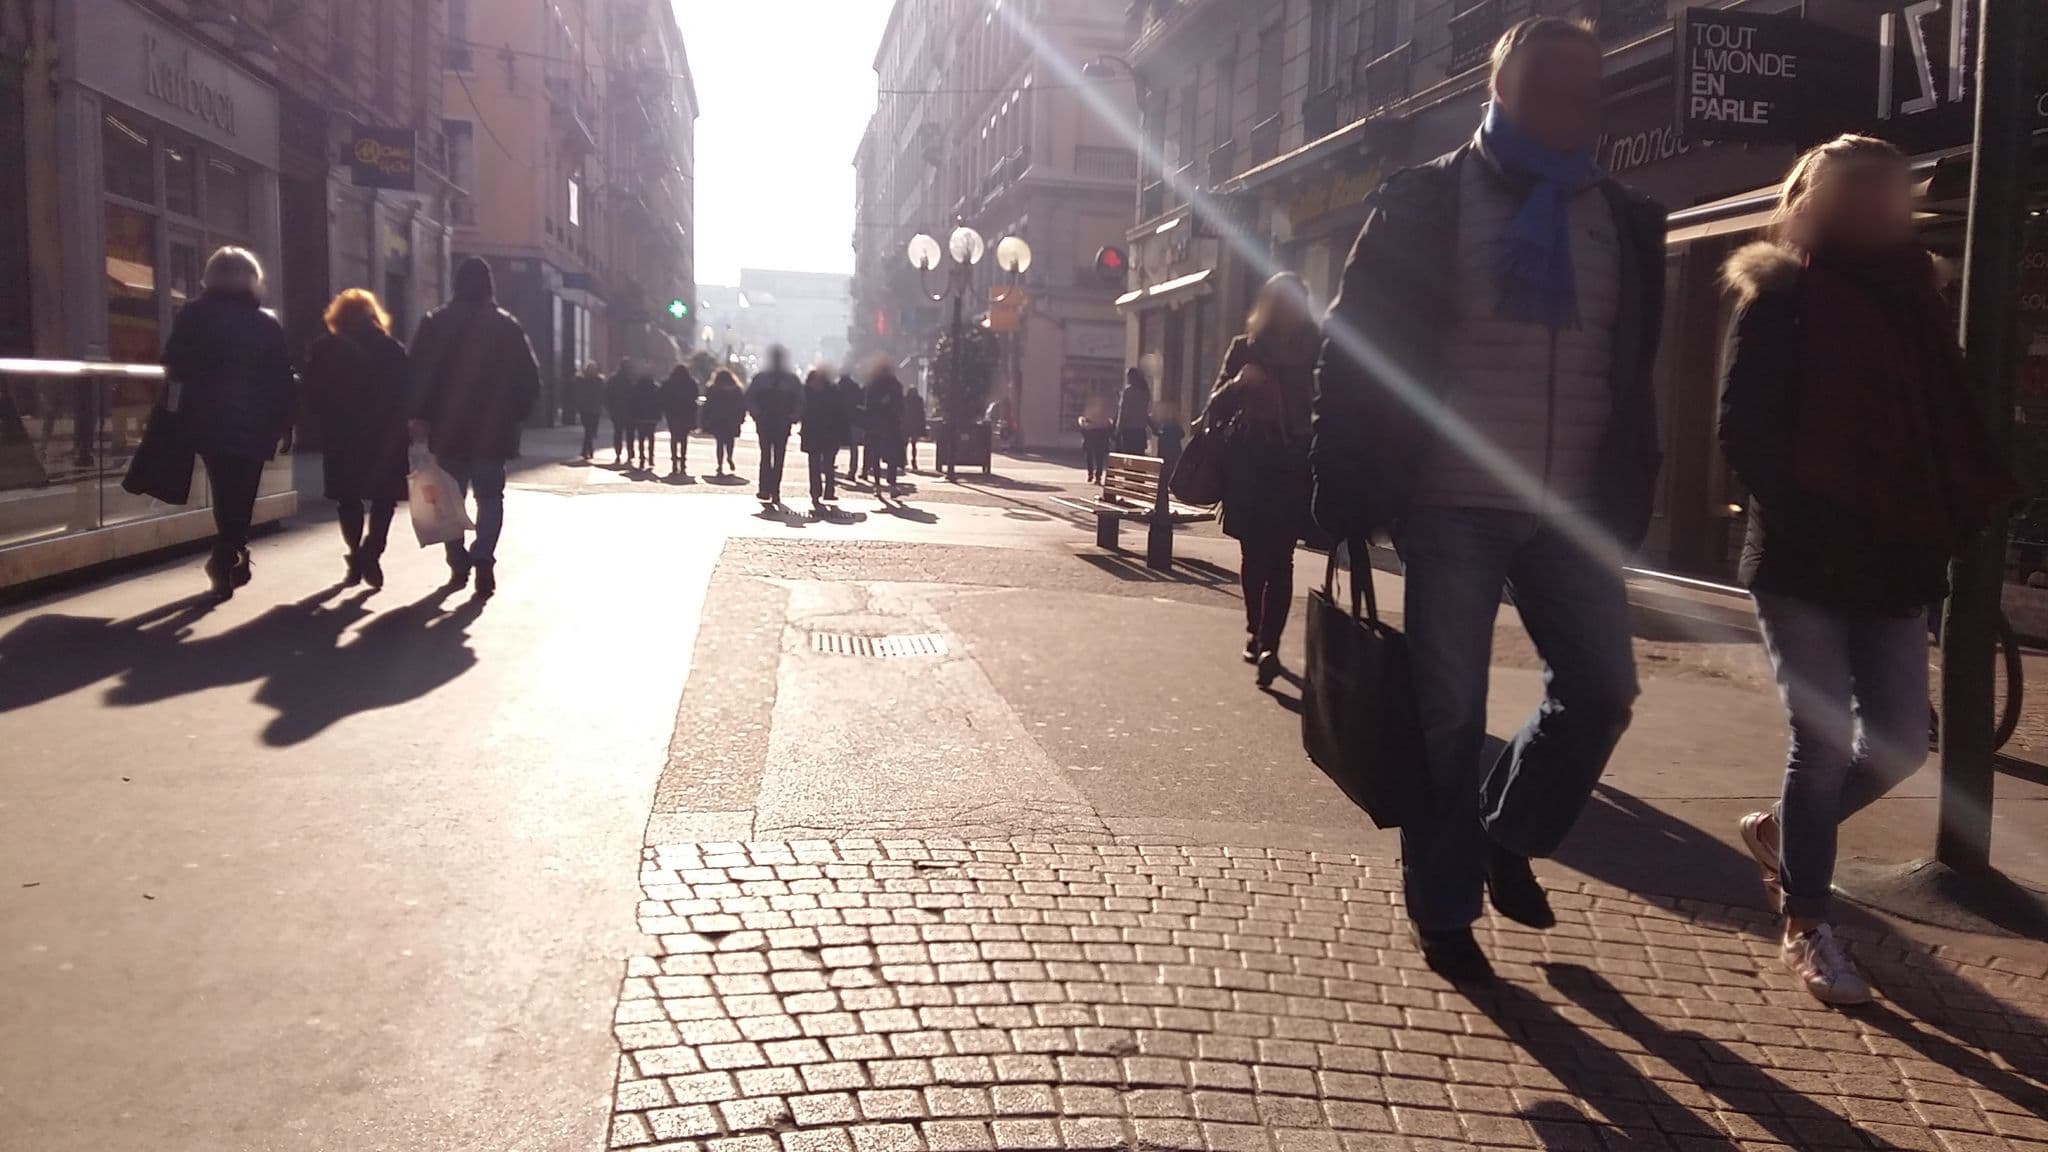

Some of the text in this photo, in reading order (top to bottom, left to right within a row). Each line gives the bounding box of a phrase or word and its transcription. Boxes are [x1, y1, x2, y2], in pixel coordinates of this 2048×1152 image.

[1691, 22, 1758, 50] TOUT
[1691, 47, 1797, 79] L'MONDE
[1691, 71, 1726, 97] EN
[1690, 96, 1769, 124] PARLE
